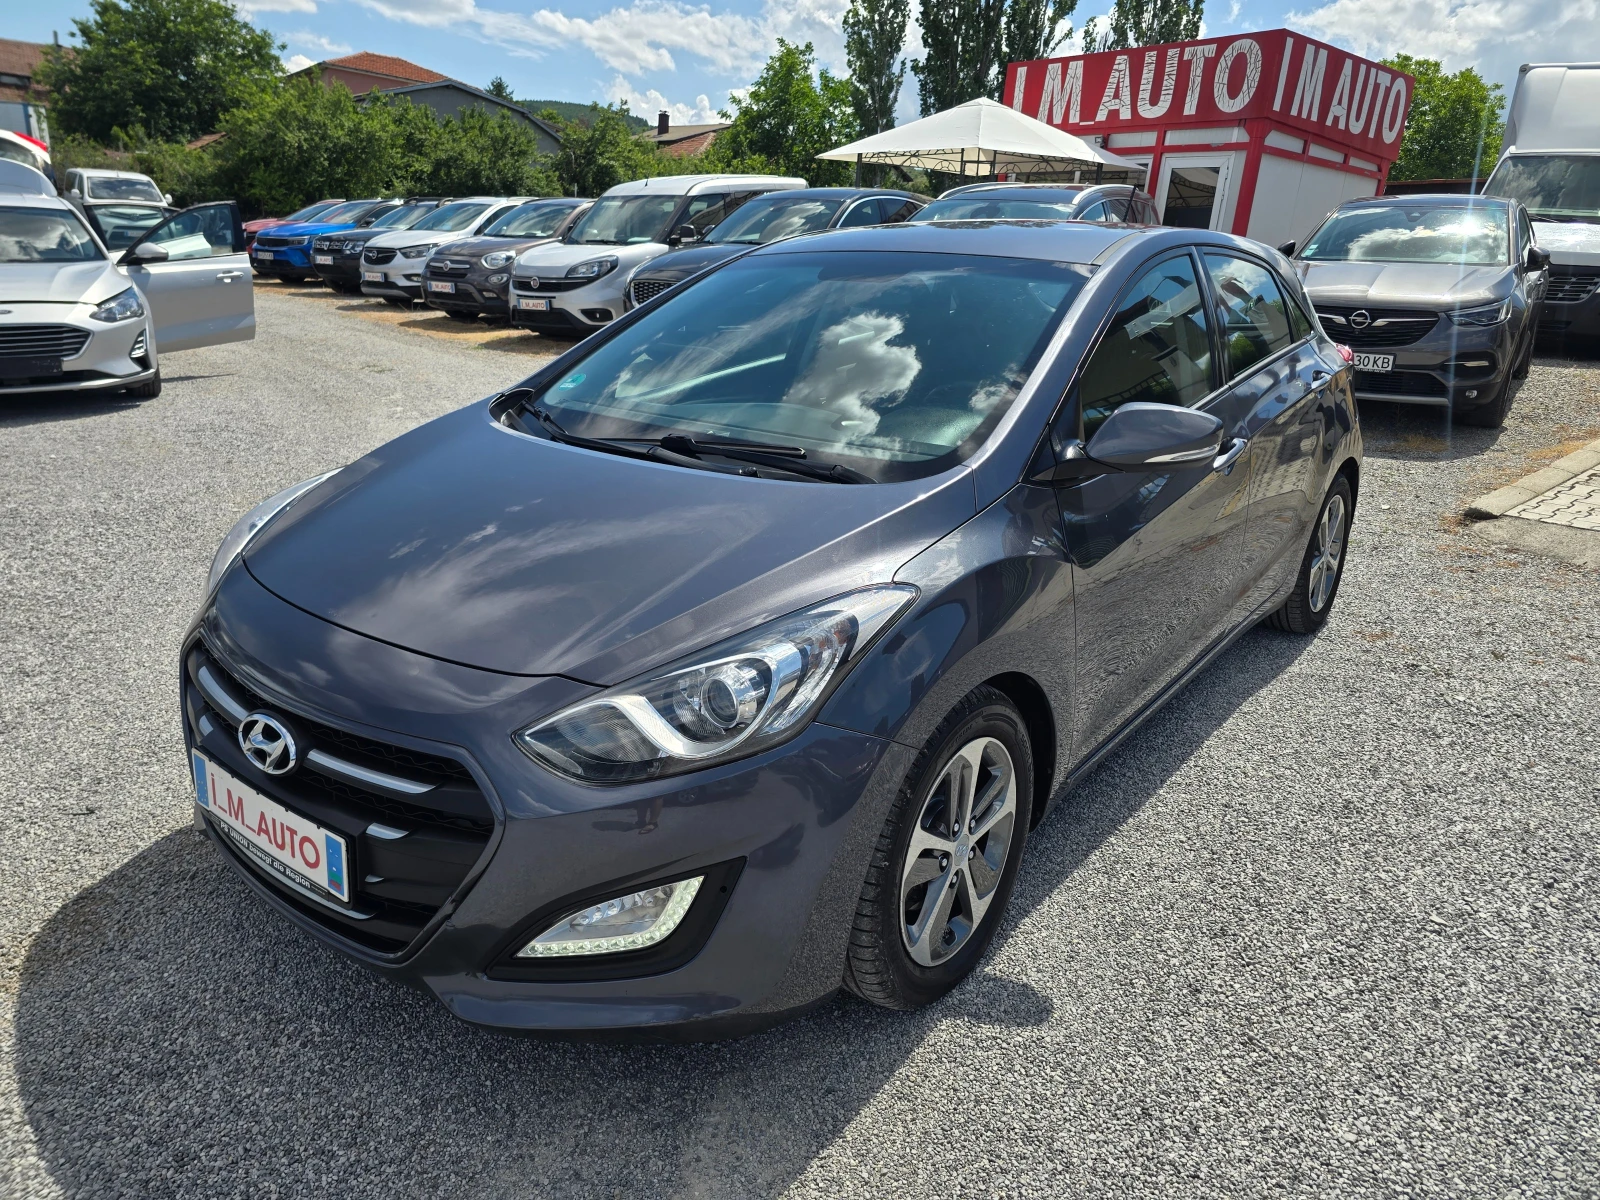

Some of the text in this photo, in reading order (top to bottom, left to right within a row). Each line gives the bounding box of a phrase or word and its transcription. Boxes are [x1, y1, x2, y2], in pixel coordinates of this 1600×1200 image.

[1272, 36, 1407, 144] I M AUTO
[1372, 356, 1390, 369] KB
[220, 820, 311, 889] PS UNION bewegt die Region
